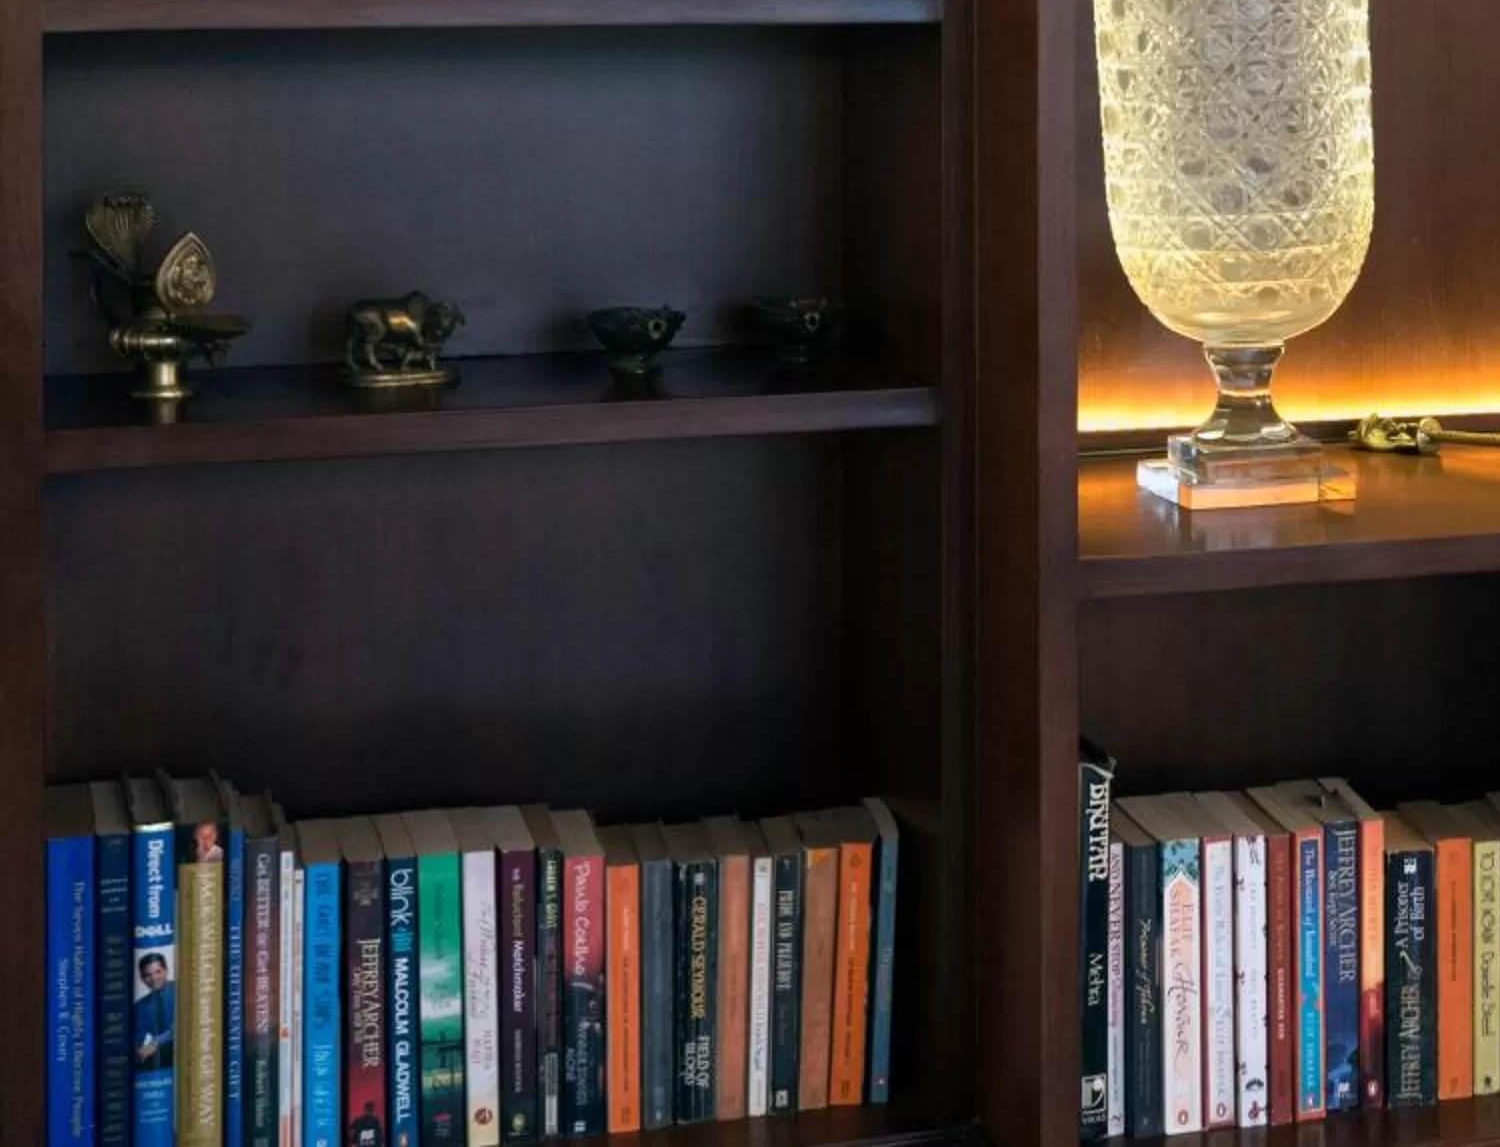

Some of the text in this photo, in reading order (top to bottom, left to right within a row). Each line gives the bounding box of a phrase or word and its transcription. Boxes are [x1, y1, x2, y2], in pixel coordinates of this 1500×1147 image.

[147, 840, 164, 918] Direct from
[1110, 853, 1120, 880] AND
[1304, 849, 1315, 866] The
[73, 881, 85, 901] The
[198, 872, 214, 919] JACK
[389, 869, 413, 927] blink
[1109, 883, 1122, 941] NEVER
[1333, 829, 1357, 982] JEFFREY ARCHER
[1394, 881, 1409, 934] Prisoner
[1411, 887, 1425, 941] of Birth
[572, 861, 591, 976] Paulo Coelho
[57, 958, 70, 1008] Stephen
[73, 945, 84, 983] Habits
[199, 921, 215, 993] WELCH
[512, 940, 526, 1014] Matchmaker
[690, 896, 706, 1020] GERALD SEYMOUR
[1087, 953, 1103, 1006] Mehra
[1111, 944, 1121, 976] STOP
[200, 996, 213, 1022] and
[357, 938, 381, 1068] JEFFREY ARCHER
[200, 1024, 213, 1052] the
[394, 957, 410, 1124] MALCOLM GLADWELL
[697, 1035, 710, 1069] FIELD
[1399, 1042, 1422, 1098] JEFFREY
[71, 1097, 84, 1137] People
[198, 1084, 215, 1126] WAY
